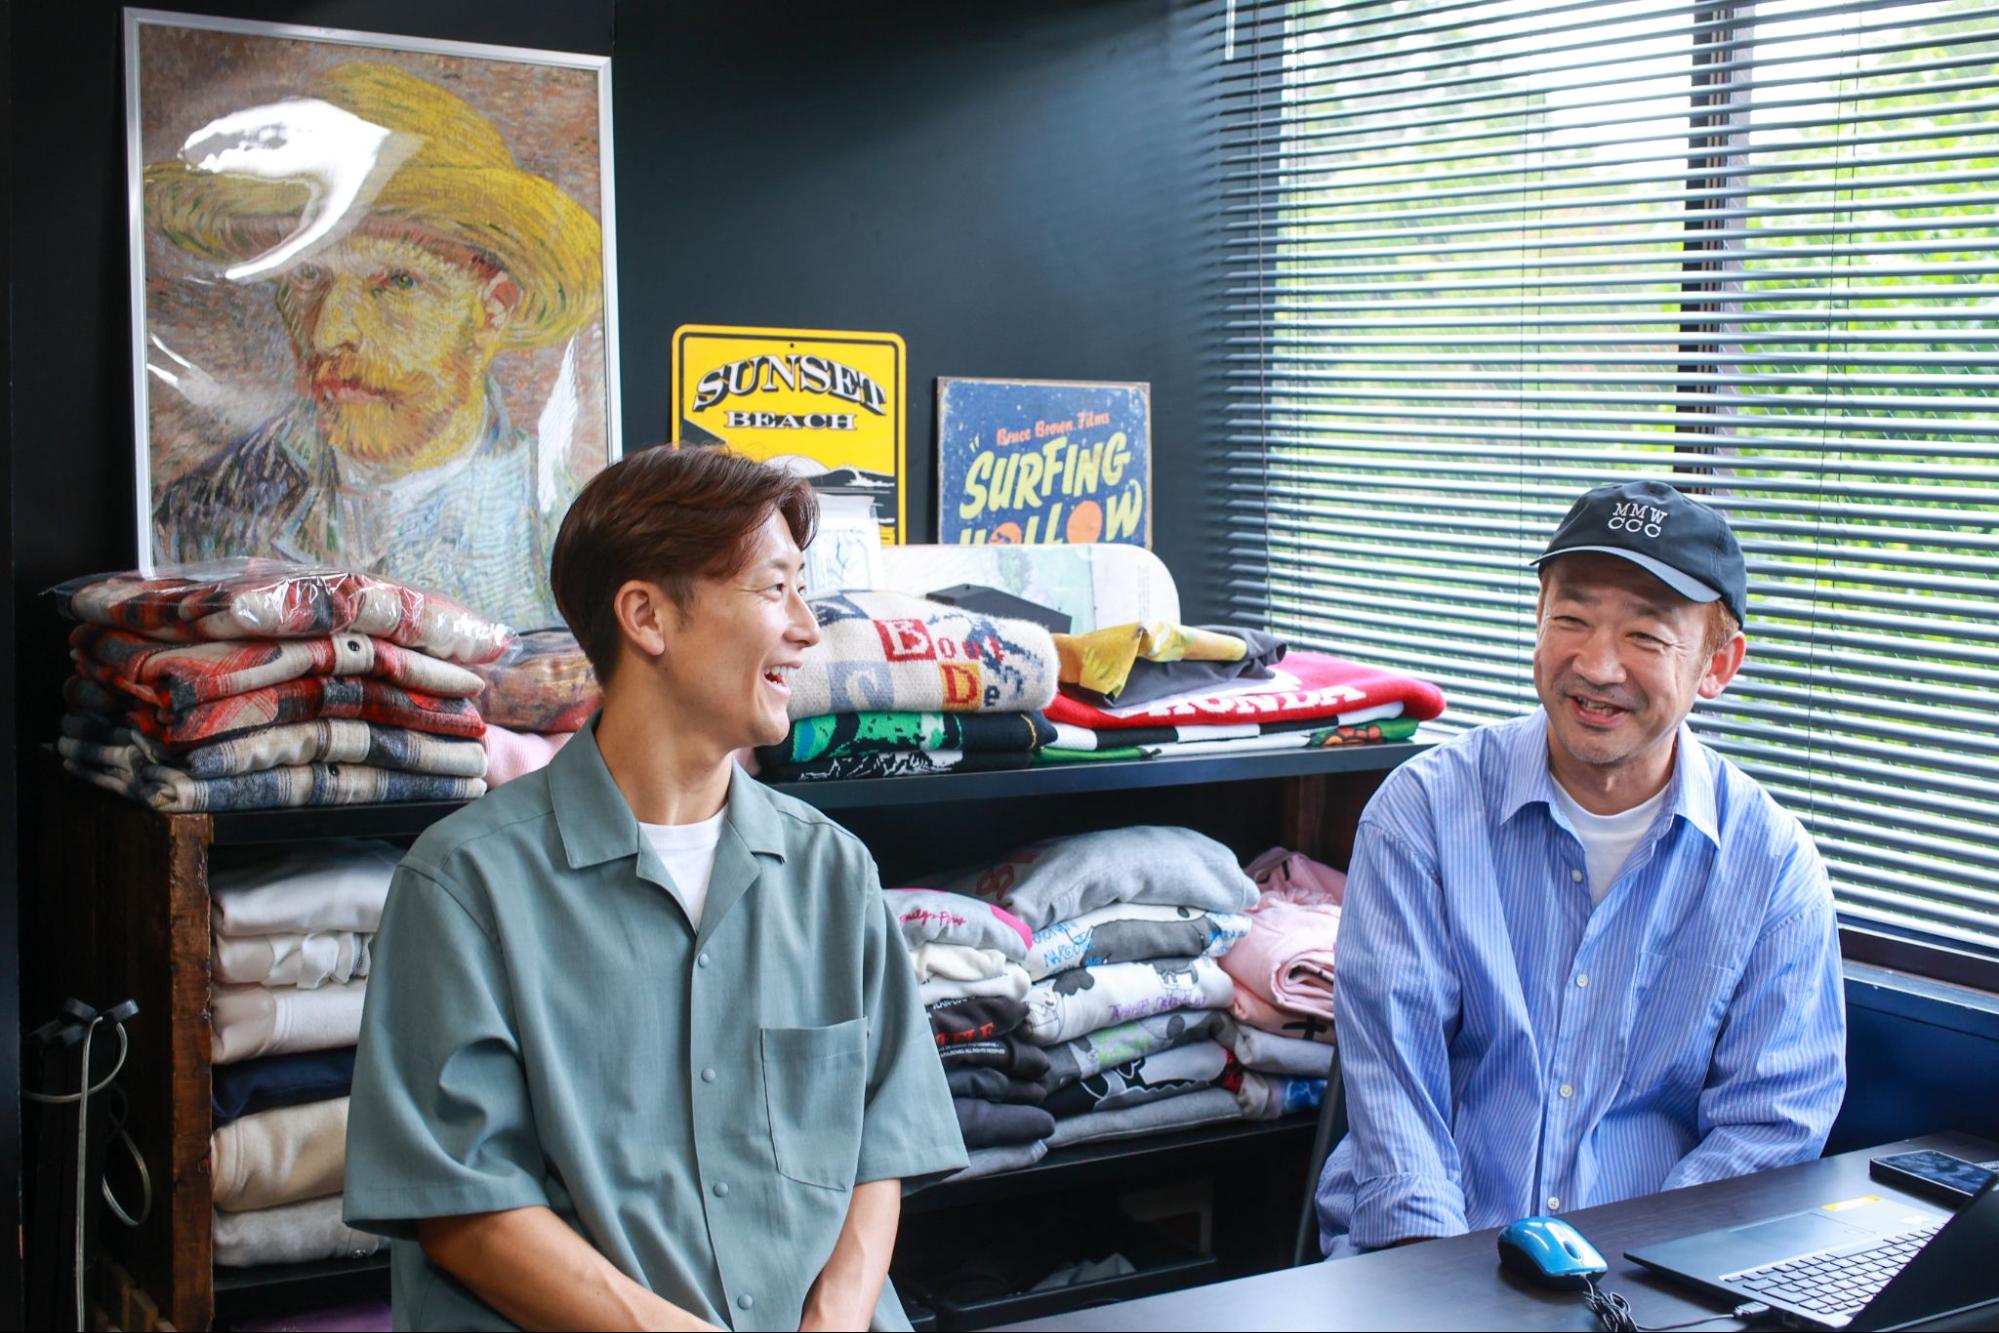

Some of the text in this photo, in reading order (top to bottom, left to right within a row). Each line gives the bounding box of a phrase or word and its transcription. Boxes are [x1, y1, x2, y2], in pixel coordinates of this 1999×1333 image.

[692, 354, 887, 416] SUNSET
[723, 410, 858, 431] BEACH
[996, 427, 1031, 446] Bruce
[1035, 419, 1073, 437] Brown
[1613, 502, 1669, 523] MMW
[1608, 516, 1661, 538] CCC
[1148, 685, 1367, 717] HONDA
